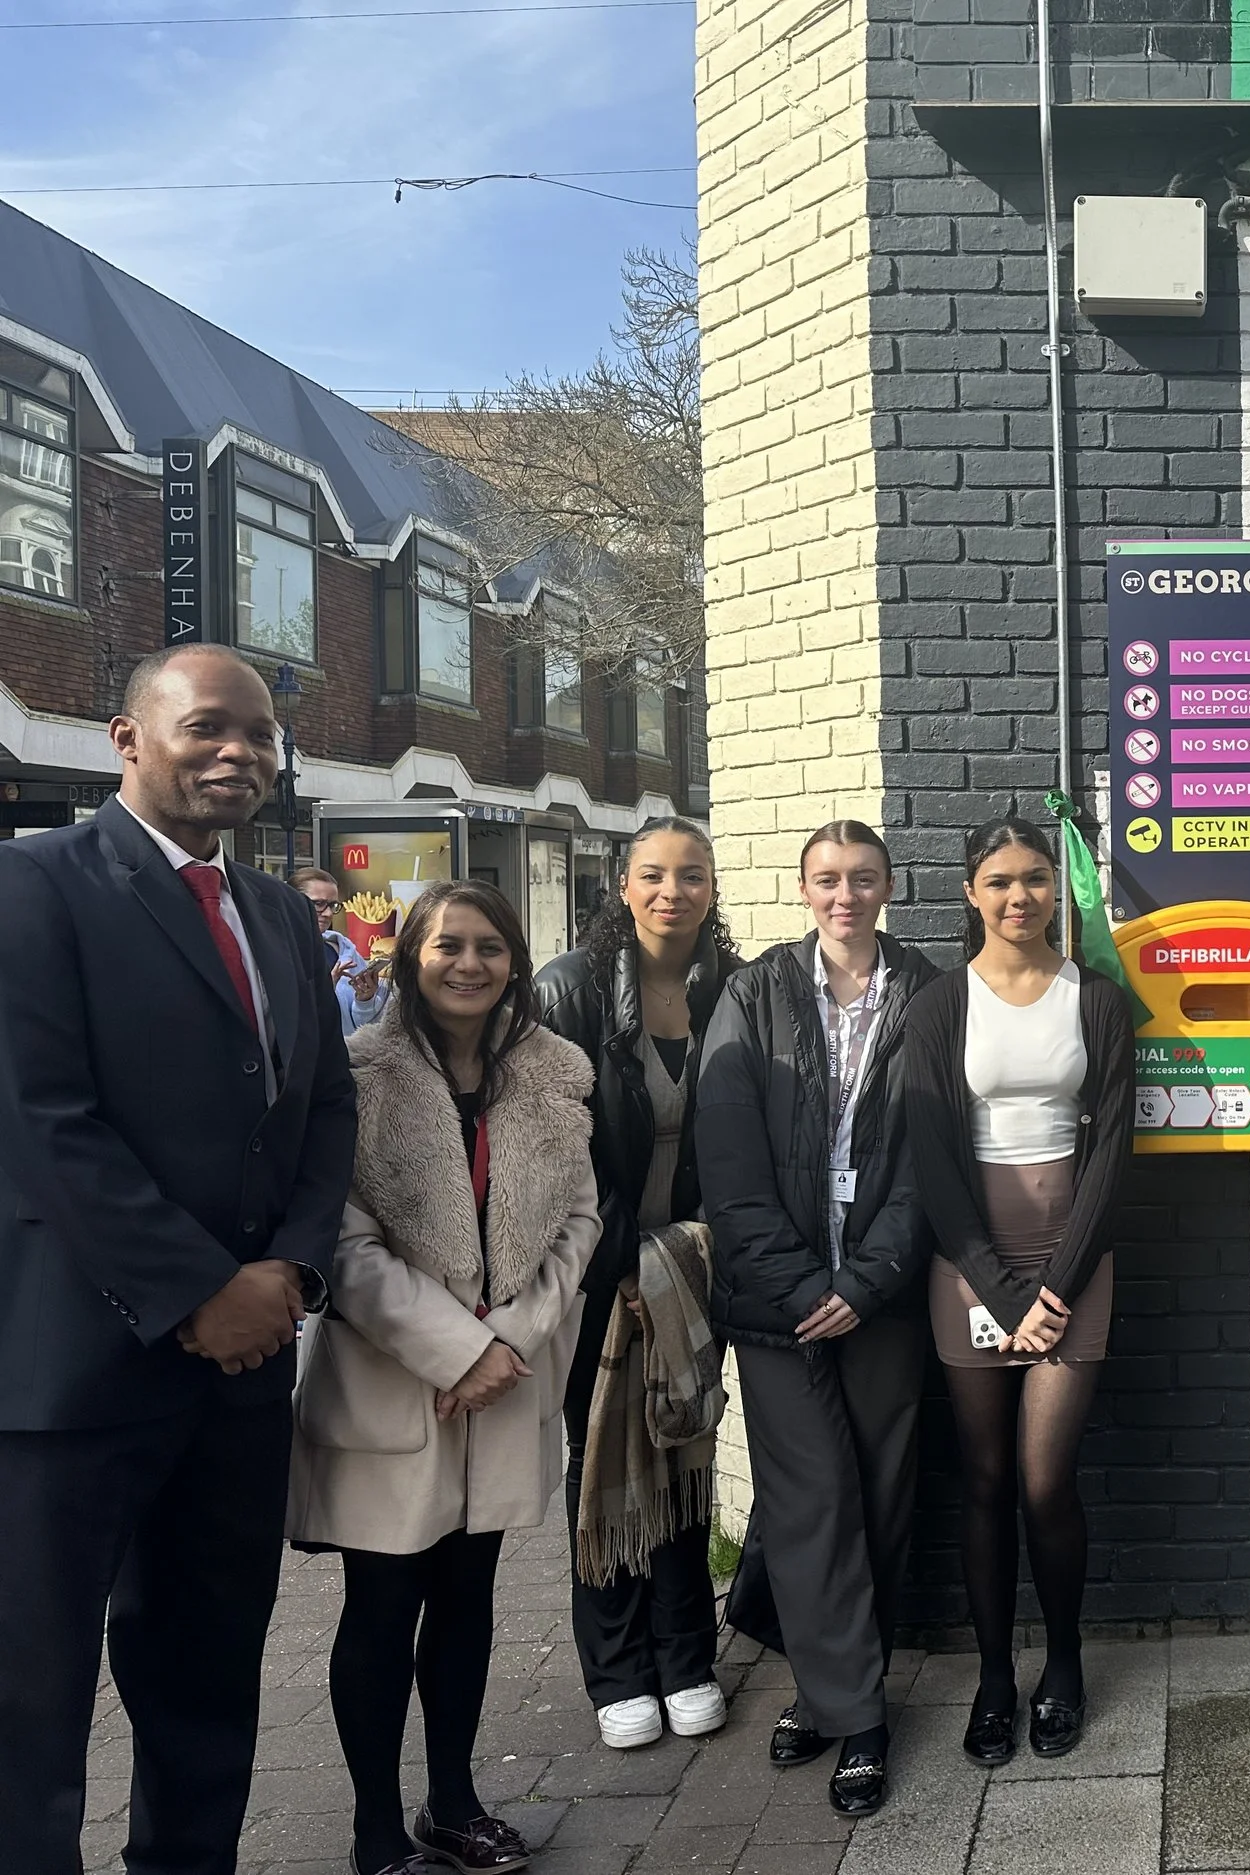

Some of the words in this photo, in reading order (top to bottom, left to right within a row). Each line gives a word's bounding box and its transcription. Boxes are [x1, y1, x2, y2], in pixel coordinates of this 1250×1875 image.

[169, 452, 195, 639] DEBENHA
[1124, 577, 1141, 588] ST
[1180, 650, 1205, 663] NO
[1181, 689, 1205, 702] NO
[1181, 704, 1228, 715] EXCEPT
[1182, 739, 1206, 752] NO
[1183, 783, 1207, 796] NO
[1183, 821, 1226, 832] CCTV
[1232, 820, 1248, 831] IN
[829, 1029, 837, 1053] SIXTH
[1172, 1047, 1206, 1062] 999
[829, 1054, 837, 1078] FORM
[1145, 1067, 1178, 1075] access
[1179, 1065, 1205, 1074] code
[1206, 1066, 1216, 1074] to
[1219, 1066, 1245, 1076] open
[844, 1067, 856, 1090] FORM
